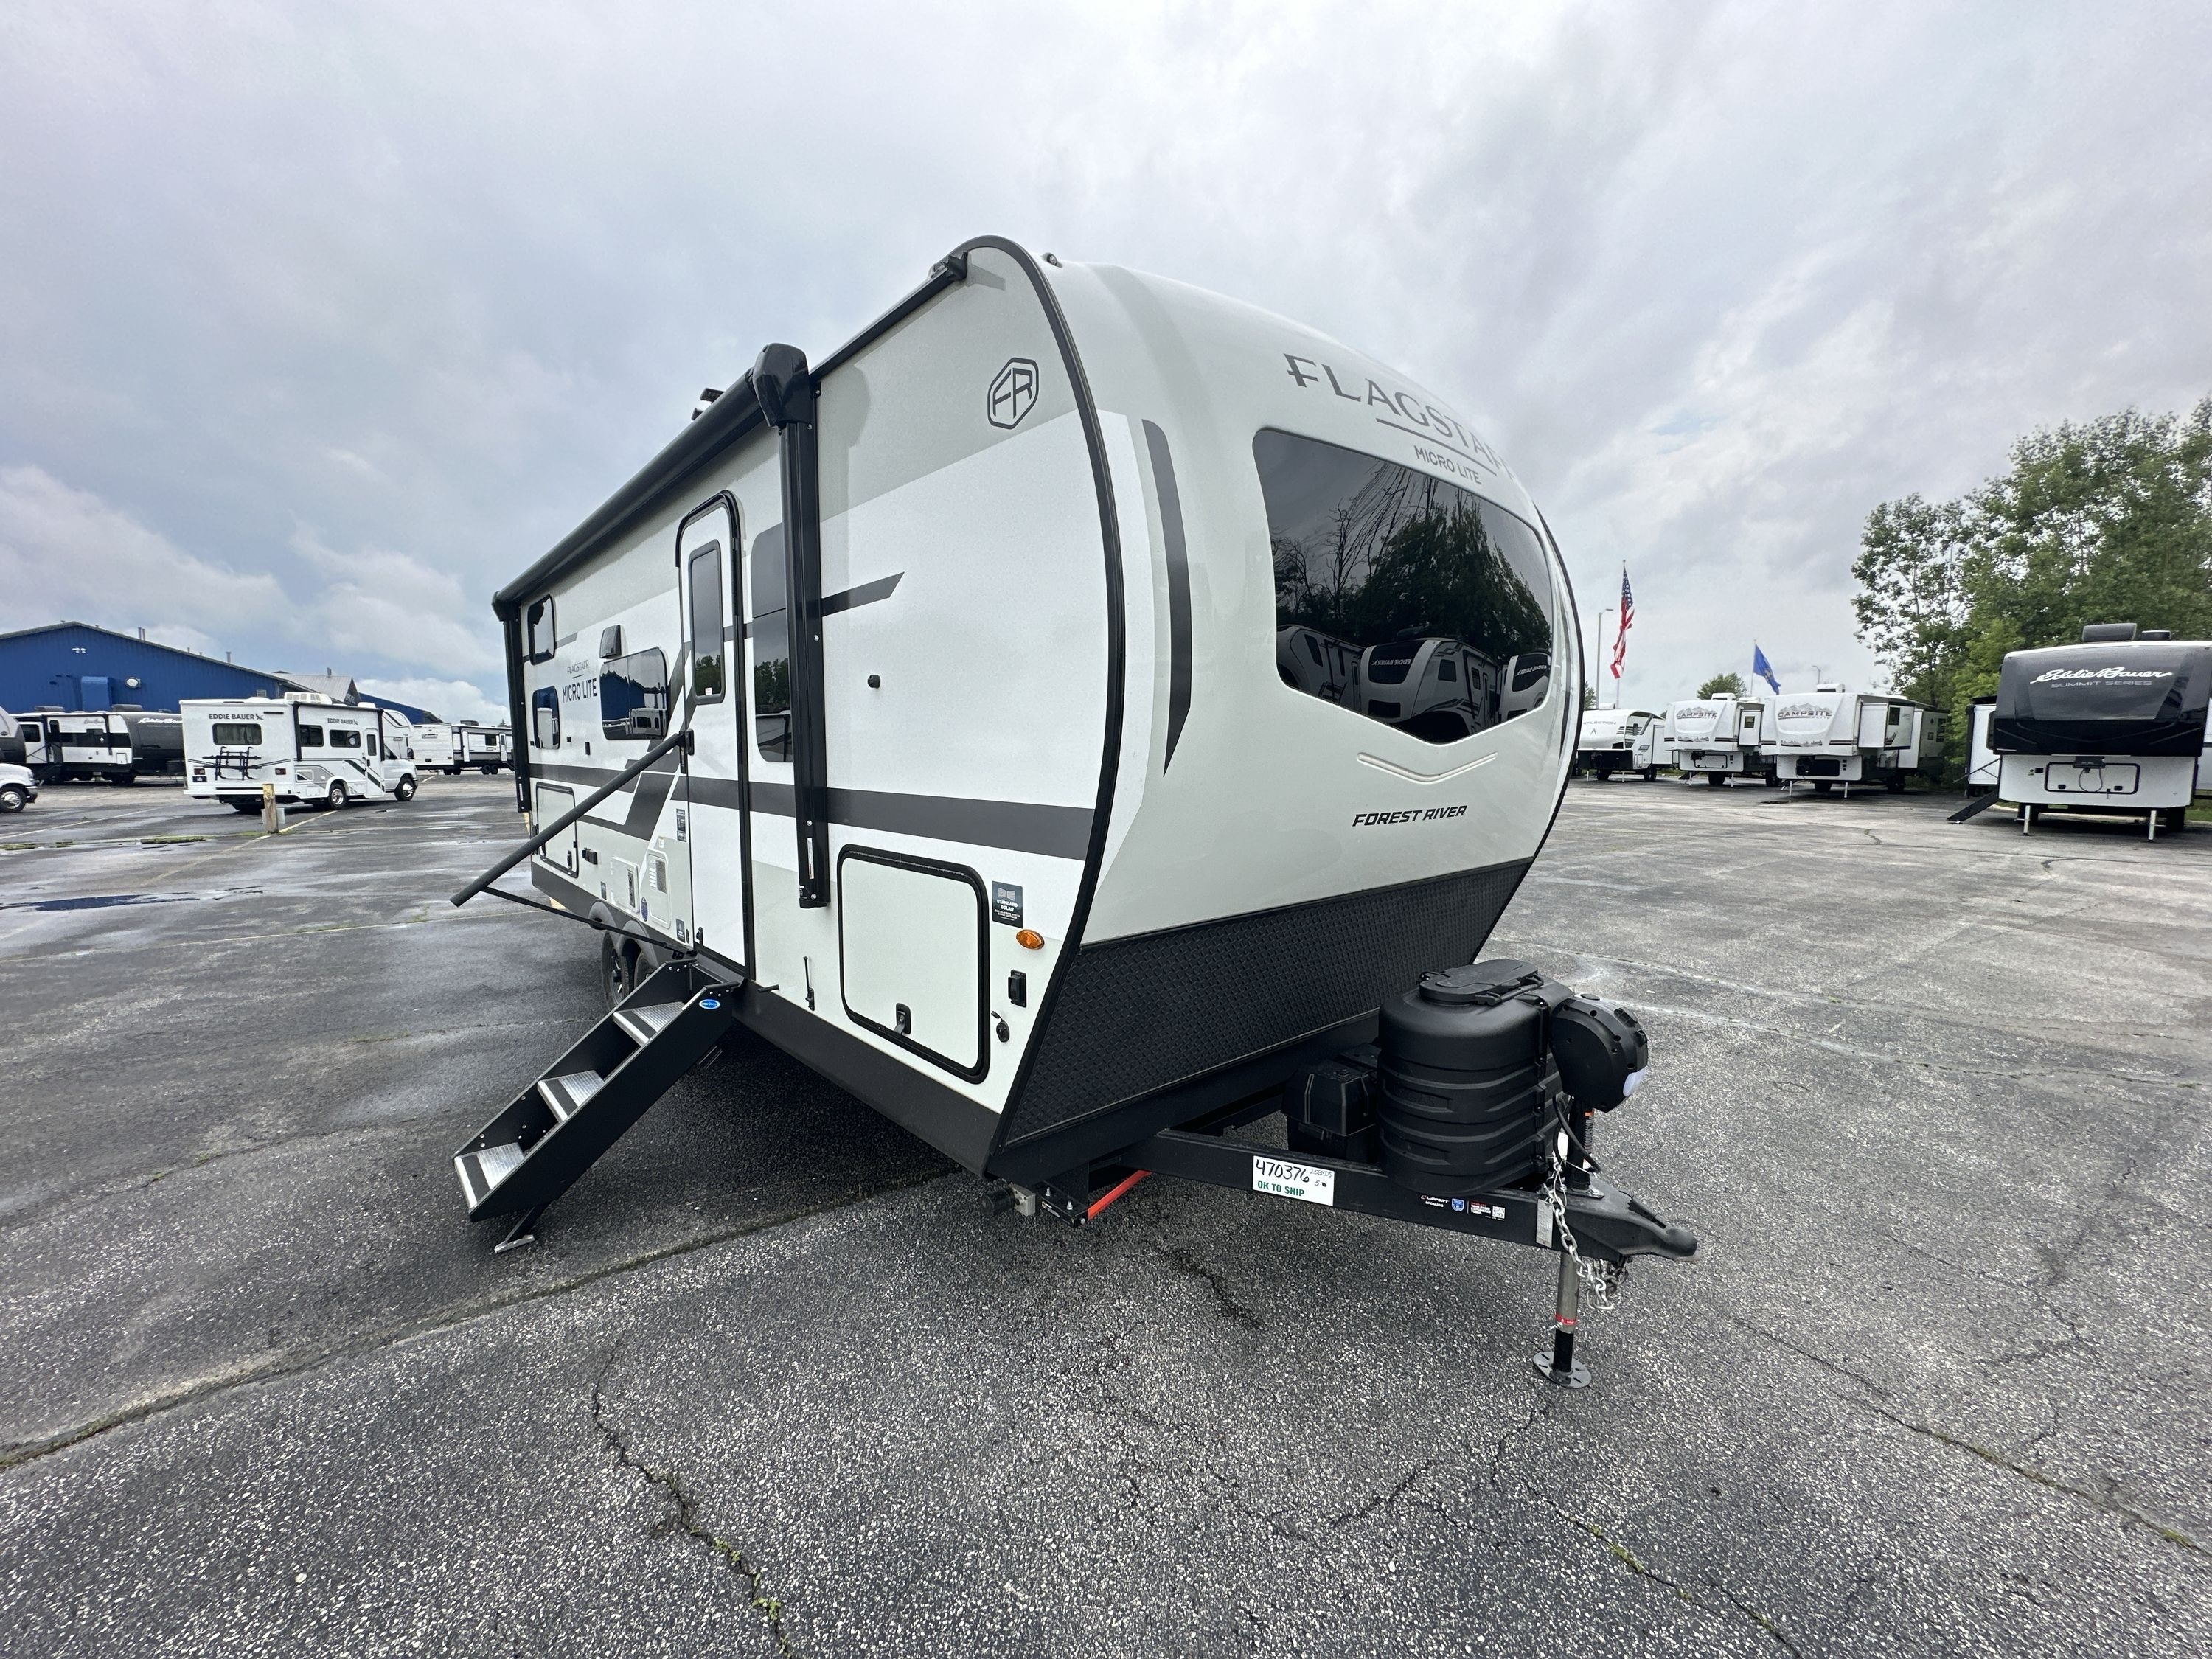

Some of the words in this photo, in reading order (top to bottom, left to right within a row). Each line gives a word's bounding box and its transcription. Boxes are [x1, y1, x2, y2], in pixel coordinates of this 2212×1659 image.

[1413, 445, 1455, 473] MICRO
[1457, 463, 1482, 485] LITE
[567, 660, 589, 674] FLAGSTAFF
[2030, 669, 2096, 684] Eddie
[2095, 667, 2174, 679] Bauer
[562, 683, 581, 703] MICRO
[582, 678, 597, 698] LITE
[2051, 681, 2101, 689] SUMMIT
[1778, 710, 1833, 718] CAMPSITE
[1352, 810, 1423, 827] FOREST
[1422, 804, 1468, 821] RIVER
[996, 898, 1018, 908] STANDARD
[1256, 1158, 1310, 1183] 470376
[1257, 1180, 1269, 1190] OK
[1271, 1183, 1282, 1192] TO
[1284, 1186, 1305, 1197] SHIP
